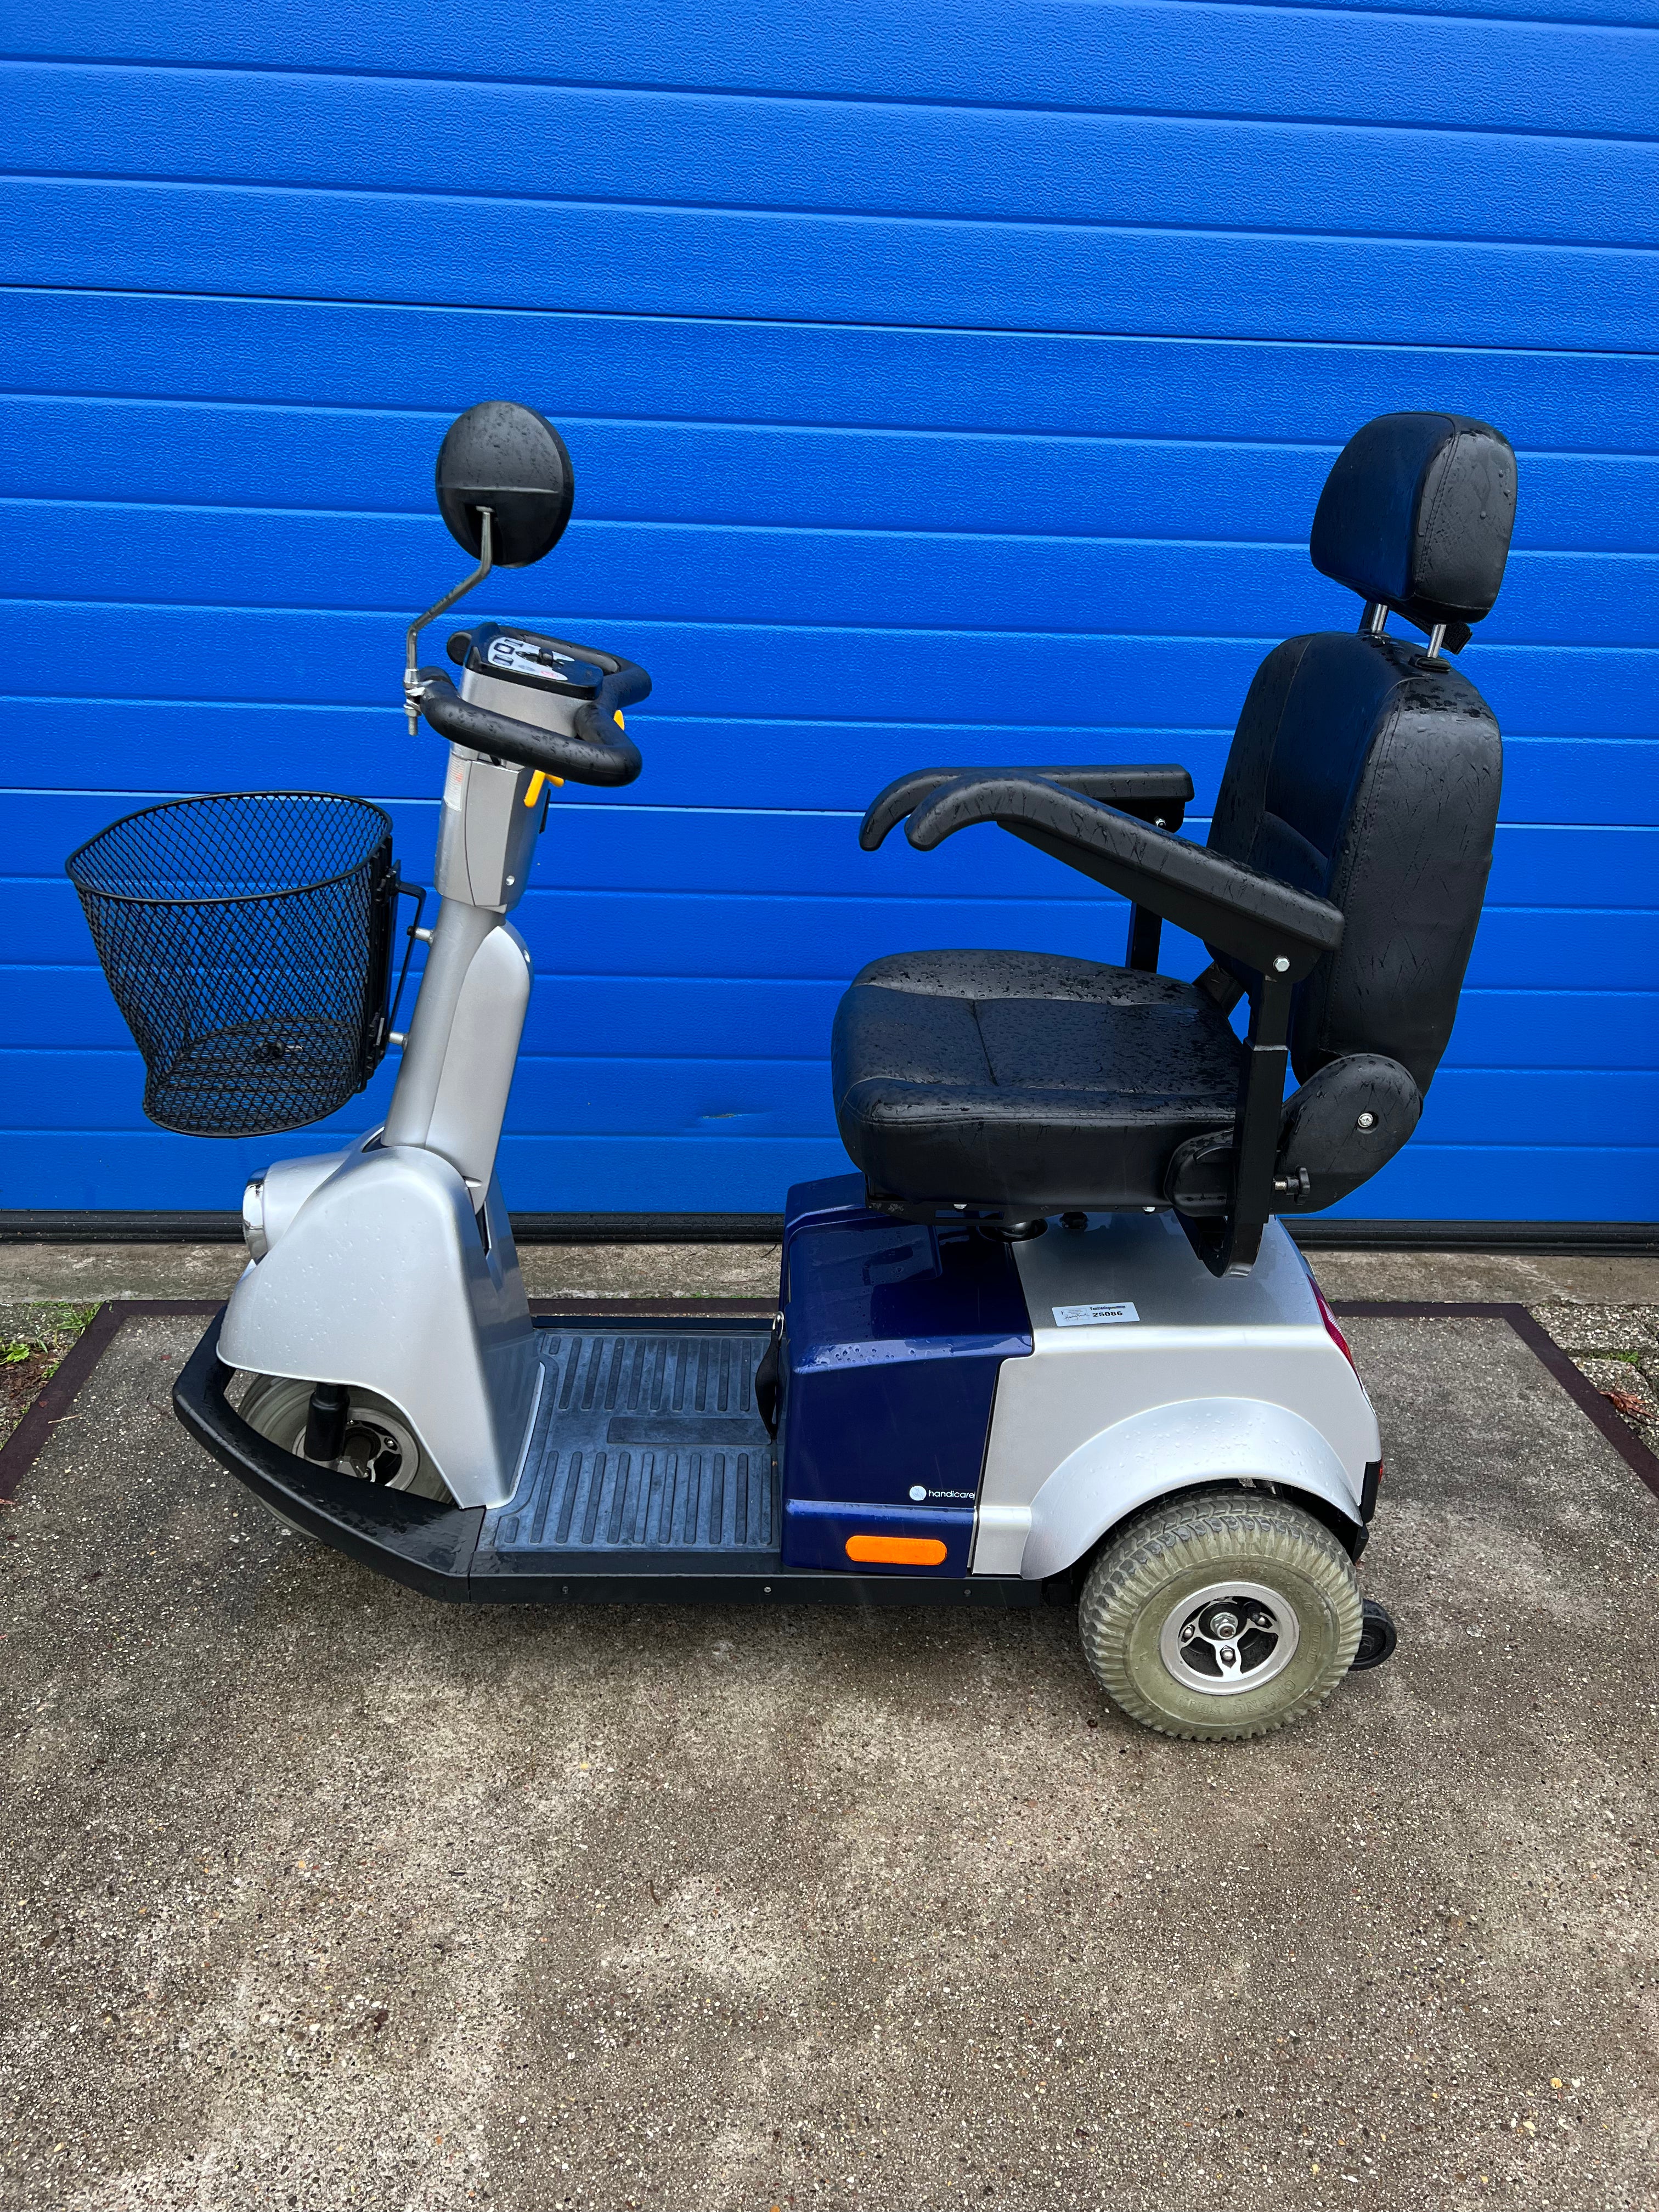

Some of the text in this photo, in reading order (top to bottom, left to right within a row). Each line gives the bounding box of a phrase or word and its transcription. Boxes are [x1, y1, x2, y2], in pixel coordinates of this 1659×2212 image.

[928, 1489, 975, 1498] handicare
[1175, 1680, 1296, 1716] CHENG SHIN
